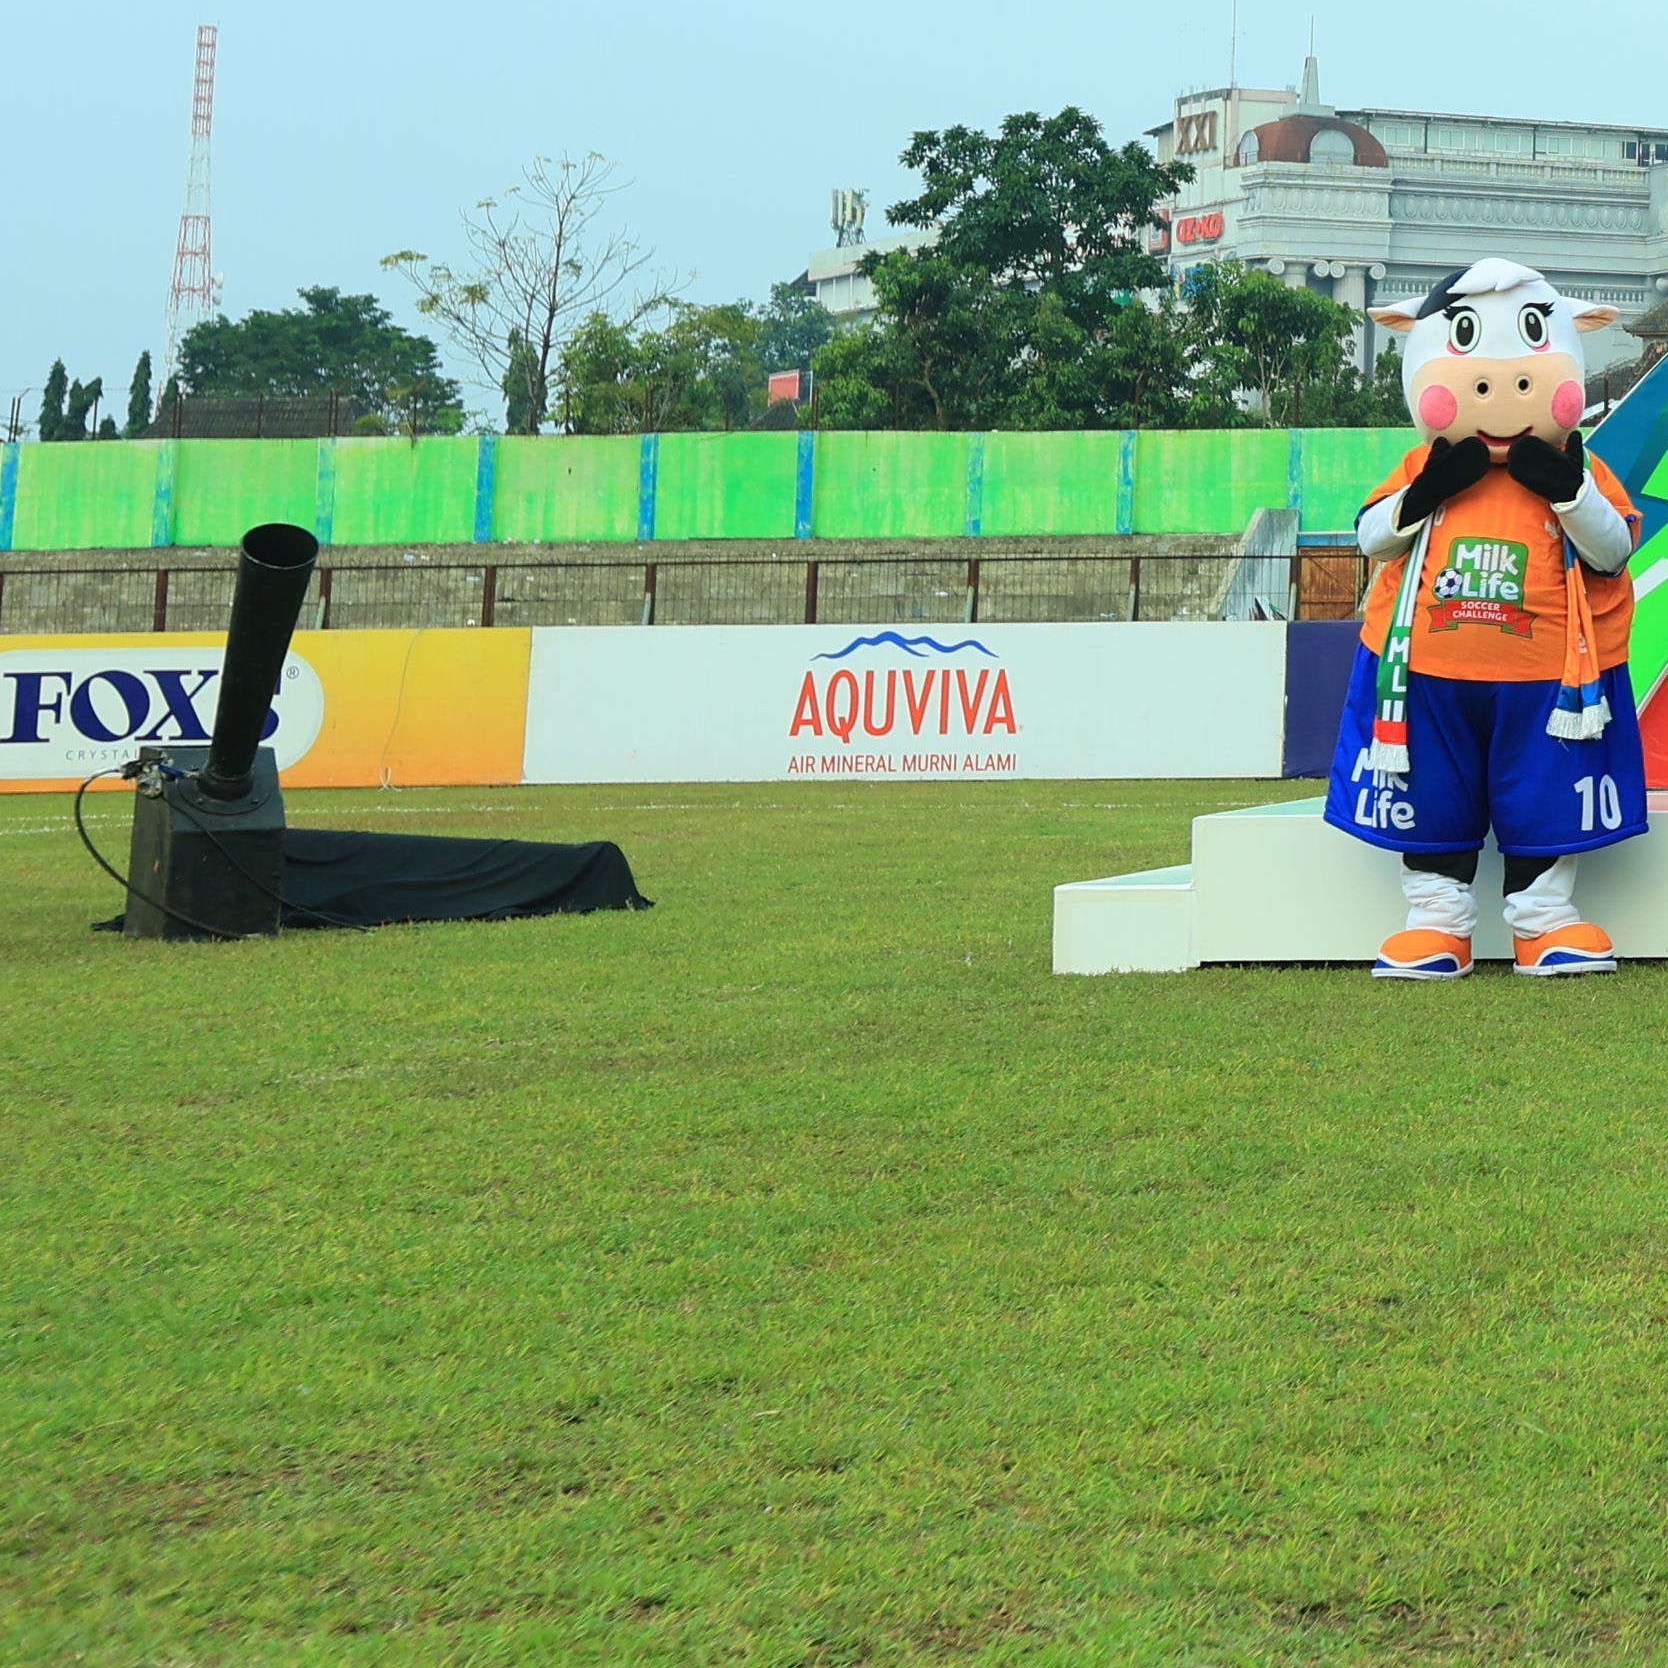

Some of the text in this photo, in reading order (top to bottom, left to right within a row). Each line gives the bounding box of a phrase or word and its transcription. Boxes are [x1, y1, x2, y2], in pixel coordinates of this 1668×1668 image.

[1175, 111, 1217, 155] XXI
[1456, 543, 1519, 576] Milk
[1461, 571, 1519, 601] Life
[1453, 611, 1508, 622] CHALLENGE
[1461, 601, 1500, 611] SOCCER
[789, 668, 1017, 744] AQUVIVA
[788, 753, 1016, 773] AIR MINERAL MURNI ALAMI
[1355, 788, 1416, 830] Life
[1574, 774, 1622, 830] 10
